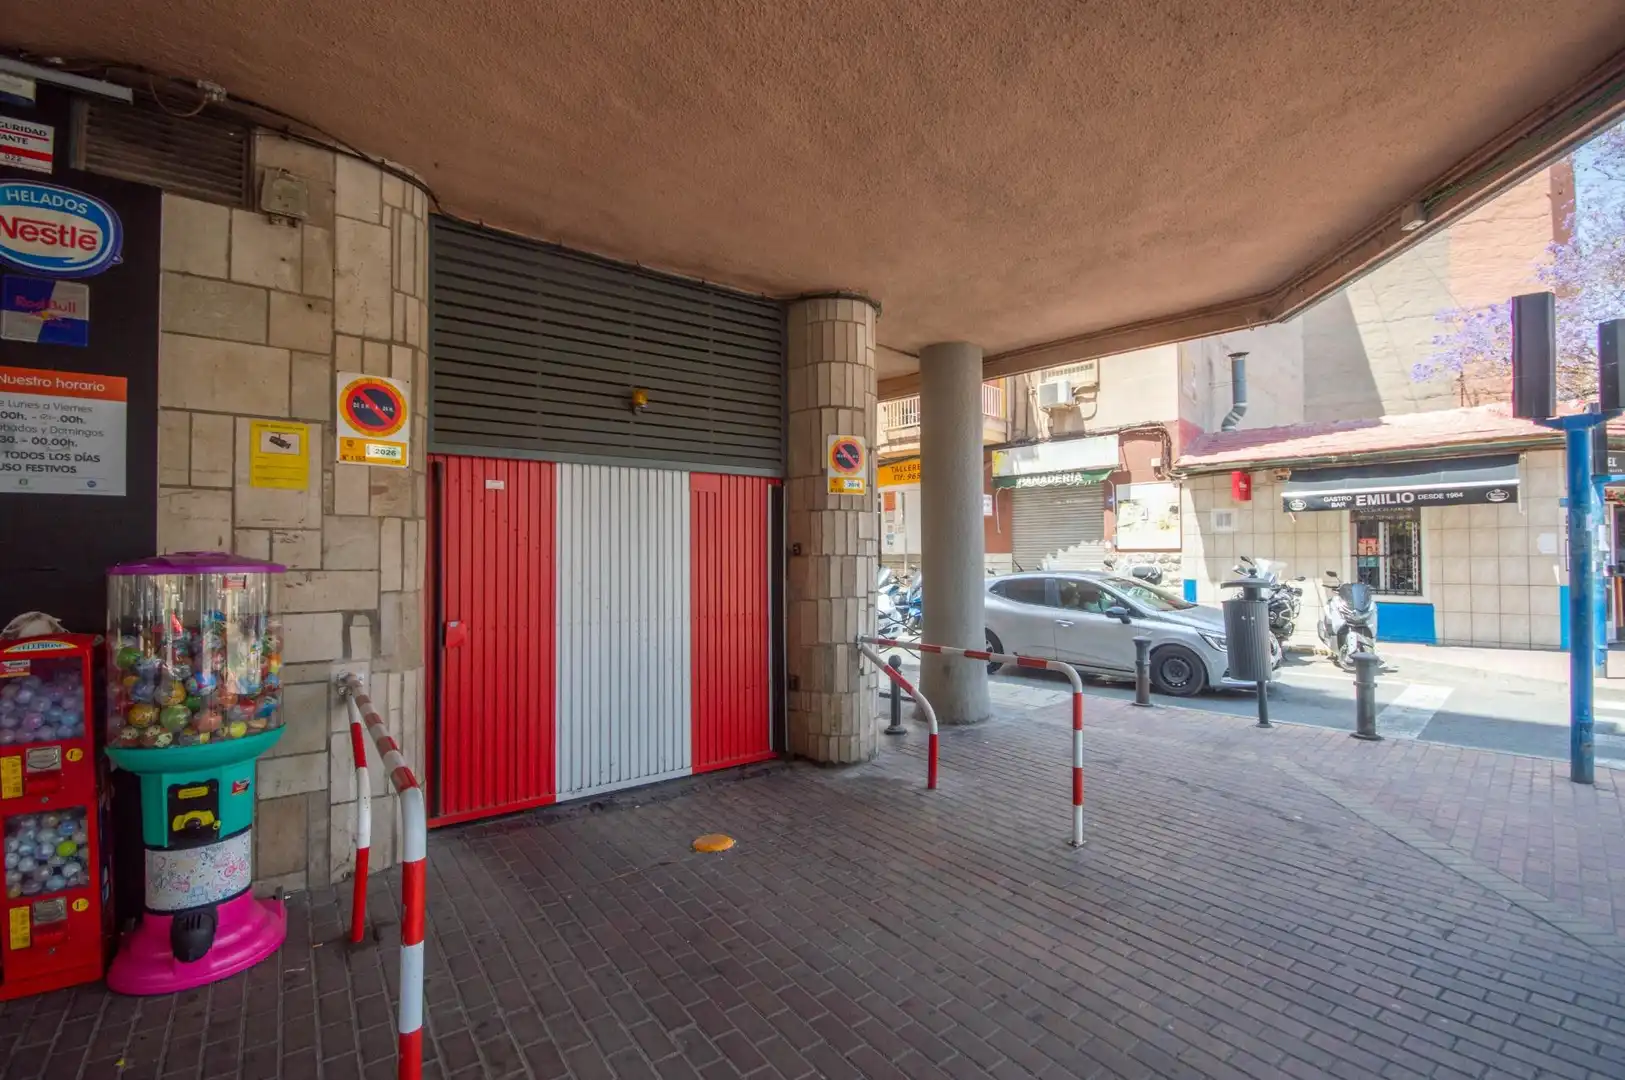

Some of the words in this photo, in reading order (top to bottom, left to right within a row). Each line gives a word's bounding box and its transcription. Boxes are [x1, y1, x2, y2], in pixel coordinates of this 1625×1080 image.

[6, 189, 88, 214] HELADOS
[50, 298, 76, 314] Bull
[0, 373, 52, 388] Nuestro
[56, 377, 106, 392] horario
[8, 400, 40, 410] Lunes
[52, 402, 94, 413] Viernes
[50, 426, 104, 438] Domingos
[4, 450, 46, 460] TODOS
[48, 452, 72, 461] LOS
[74, 452, 101, 463] DÍAS
[374, 448, 396, 456] 2026
[26, 464, 77, 474] FESTIVOS
[891, 464, 920, 473] TALLERE
[1019, 472, 1084, 485] PANADERIA
[1323, 495, 1352, 503] GASTRO
[1355, 492, 1415, 507] EMILIO
